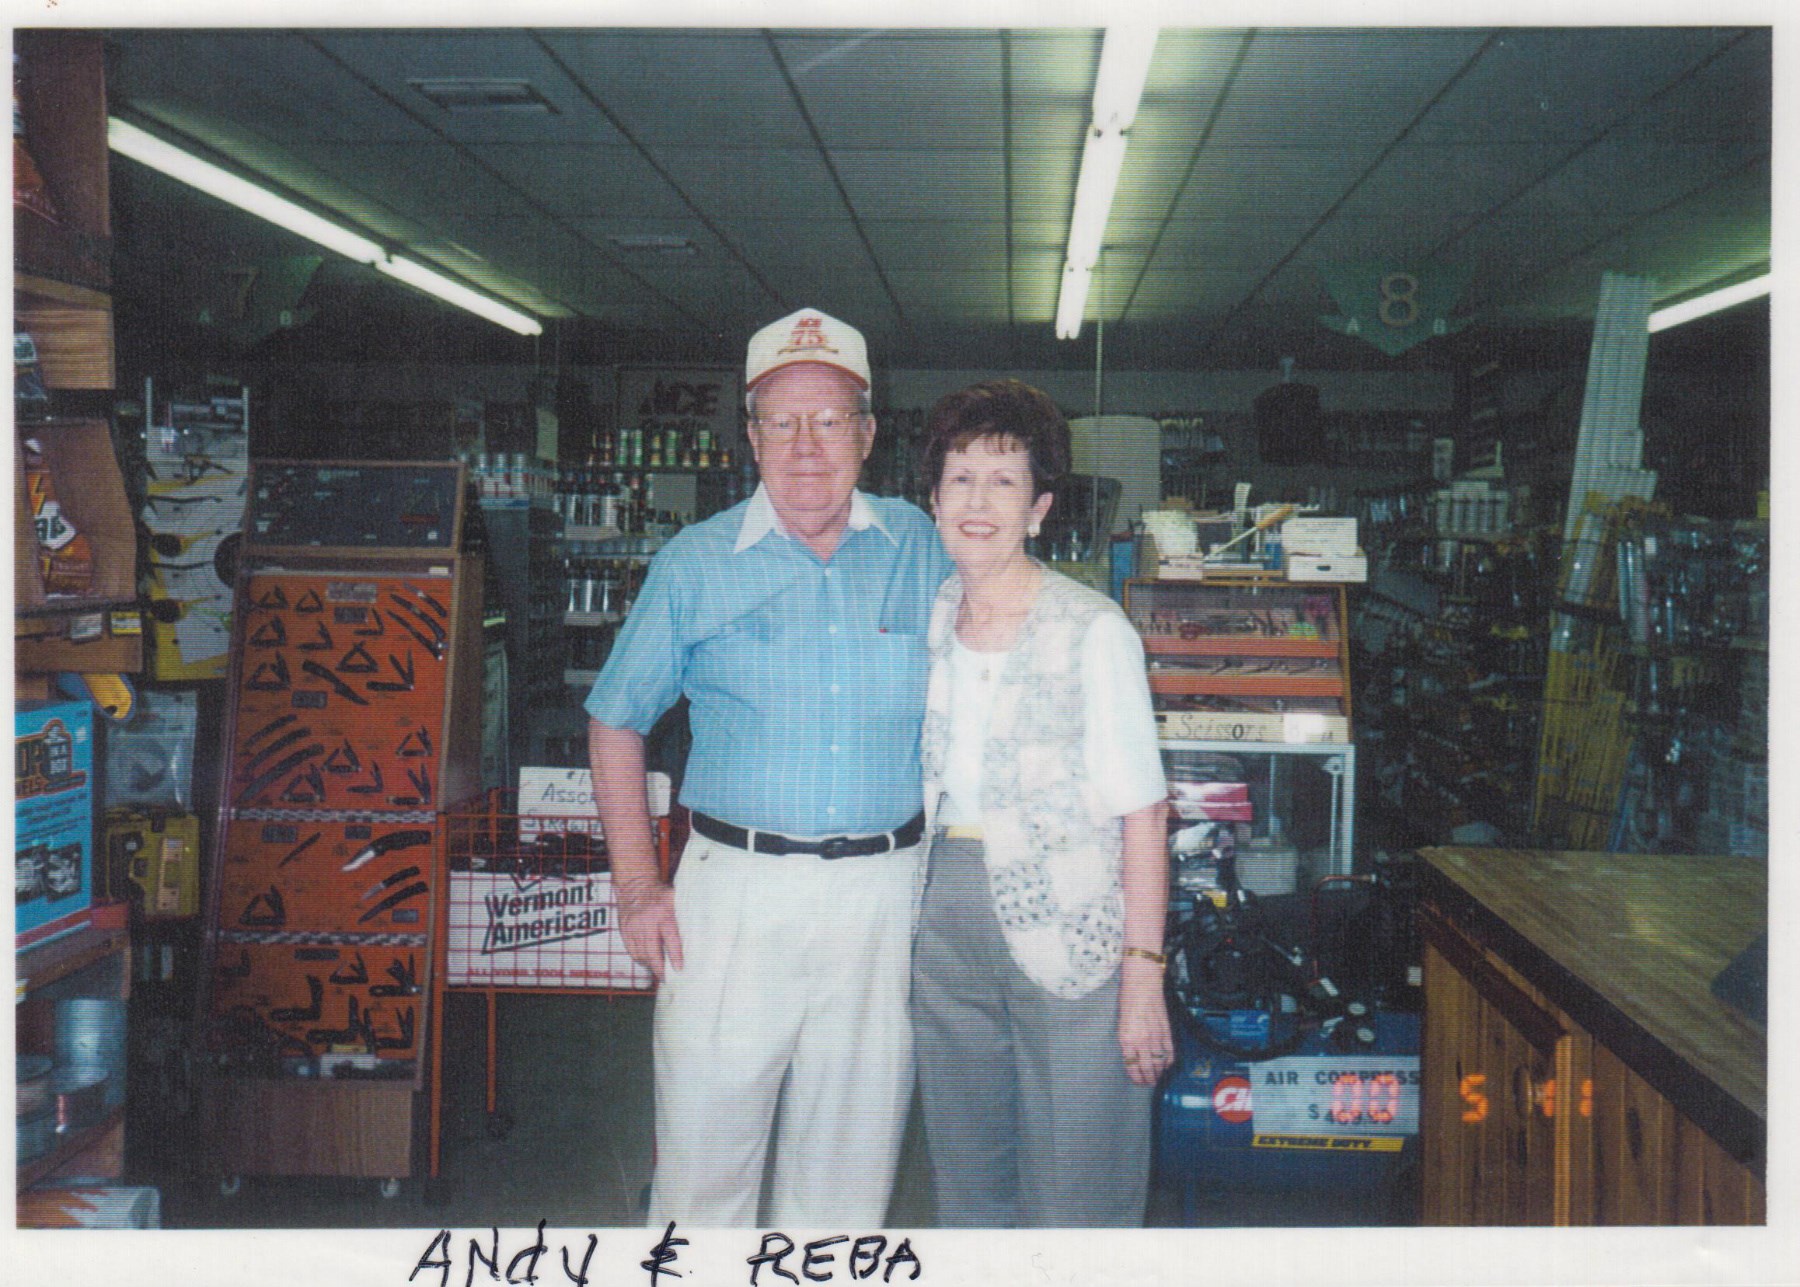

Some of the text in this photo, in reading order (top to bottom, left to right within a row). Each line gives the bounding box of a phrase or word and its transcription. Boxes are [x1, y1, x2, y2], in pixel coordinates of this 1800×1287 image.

[1379, 271, 1420, 328] 8
[1346, 316, 1360, 334] A
[638, 380, 722, 416] ACE
[492, 881, 594, 918] Vermont
[491, 907, 607, 946] American
[1265, 1071, 1299, 1085] AIR
[747, 1230, 923, 1286] REBA
